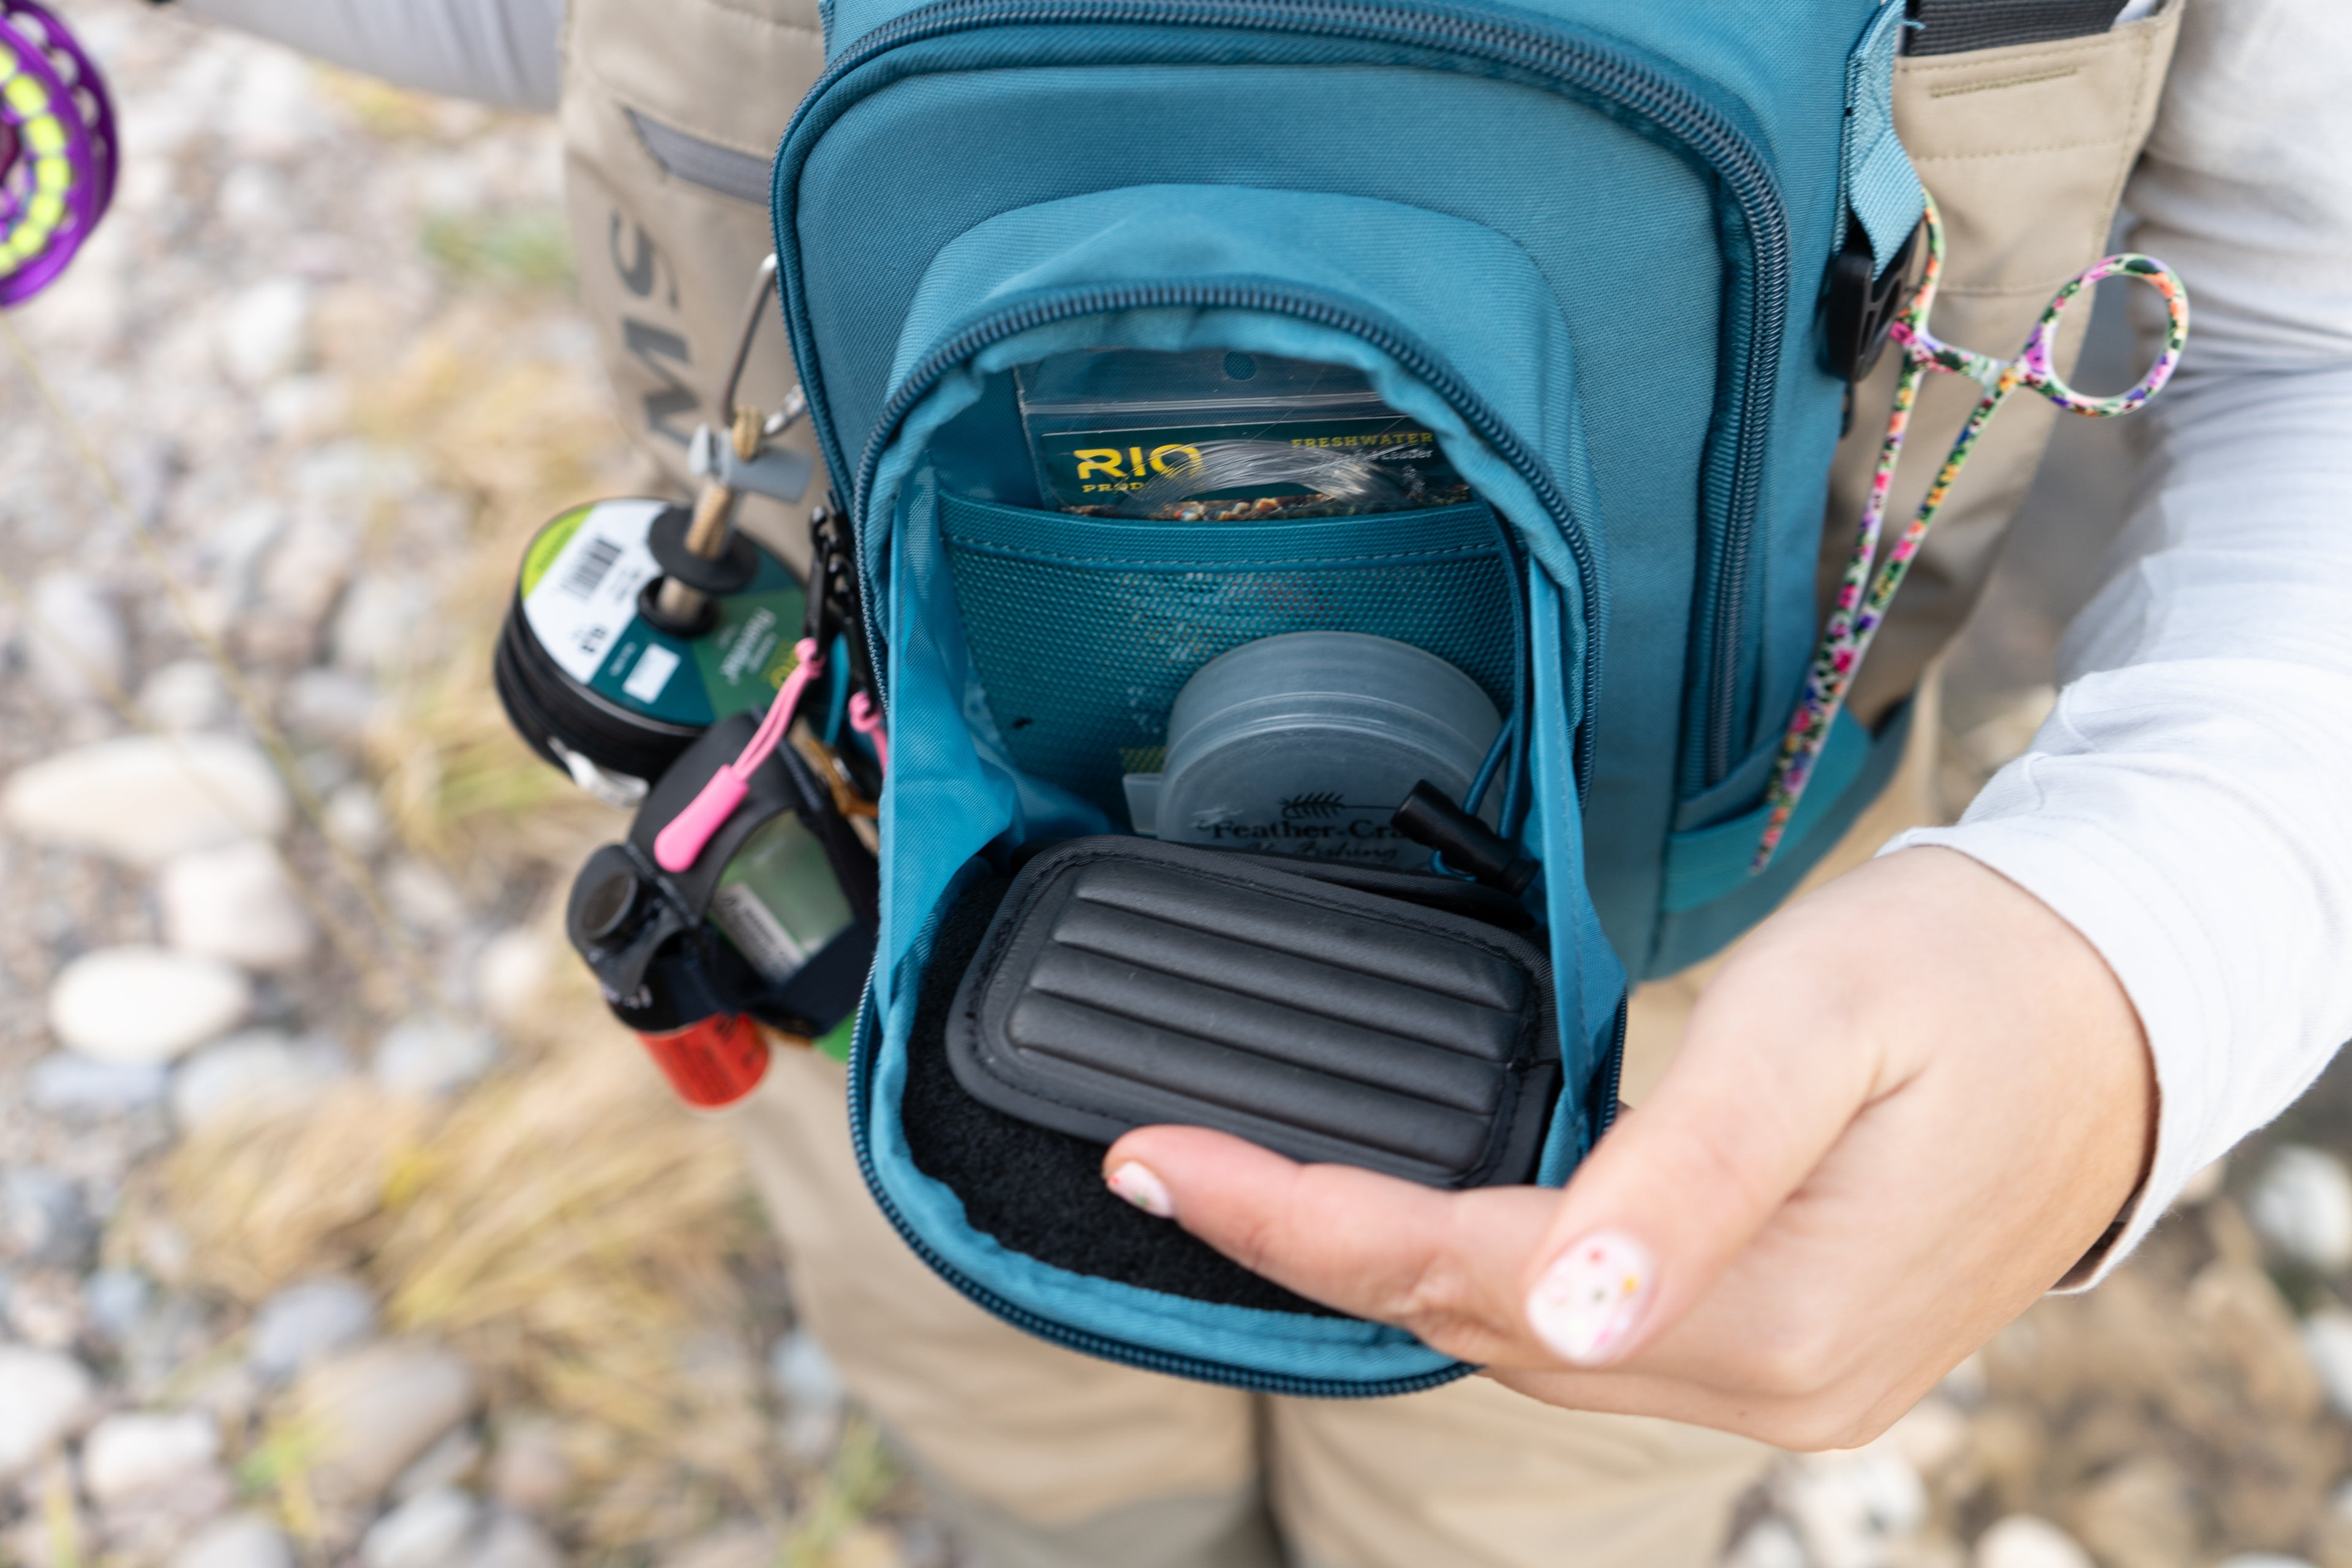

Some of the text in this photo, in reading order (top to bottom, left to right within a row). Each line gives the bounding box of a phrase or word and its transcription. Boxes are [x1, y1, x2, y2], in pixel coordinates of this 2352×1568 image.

[1291, 432, 1434, 448] FRESHWATER
[1073, 443, 1204, 480] RIO
[1082, 481, 1145, 494] PROD
